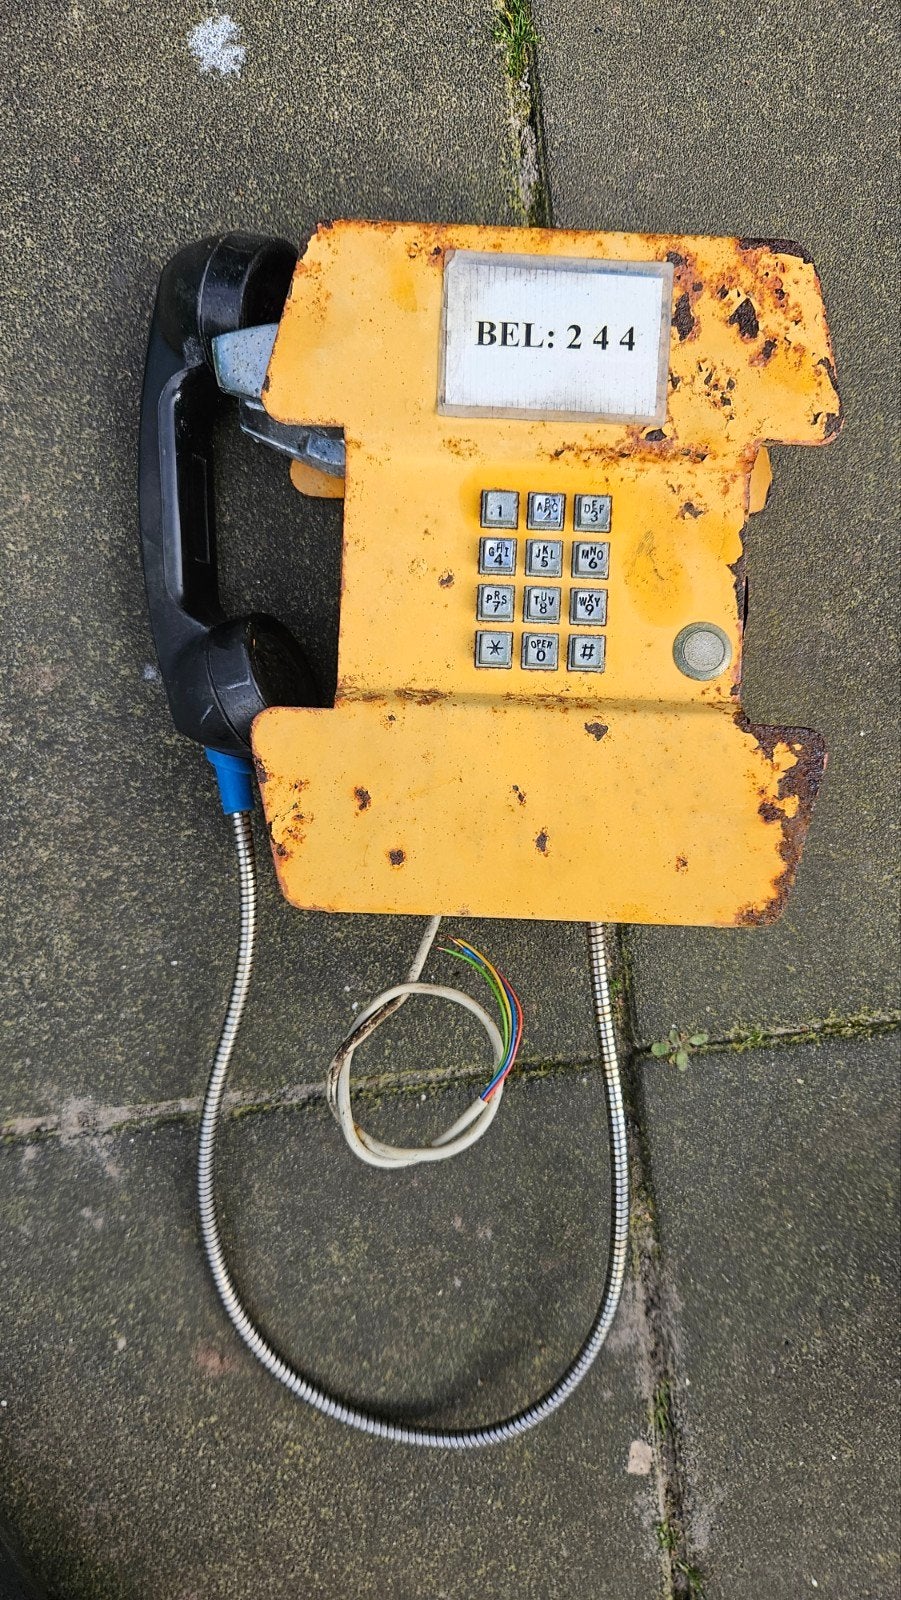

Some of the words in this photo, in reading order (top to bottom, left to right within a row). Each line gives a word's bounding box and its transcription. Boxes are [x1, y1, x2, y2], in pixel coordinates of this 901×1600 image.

[475, 320, 554, 349] BEL:
[537, 498, 558, 512] ABC
[584, 500, 605, 514] DEF
[543, 509, 551, 520] 2
[590, 511, 598, 522] 3
[489, 543, 509, 557] GHI
[535, 545, 555, 559] JKL
[581, 546, 603, 560] MNO
[494, 554, 503, 565] 4
[540, 556, 548, 567] 5
[589, 558, 597, 569] 6
[486, 591, 507, 604] PRS
[534, 592, 554, 606] TUV
[579, 594, 600, 607] WXY
[493, 601, 500, 613] 7
[540, 602, 547, 614] 8
[585, 604, 594, 616] 9
[531, 639, 552, 649] OPER
